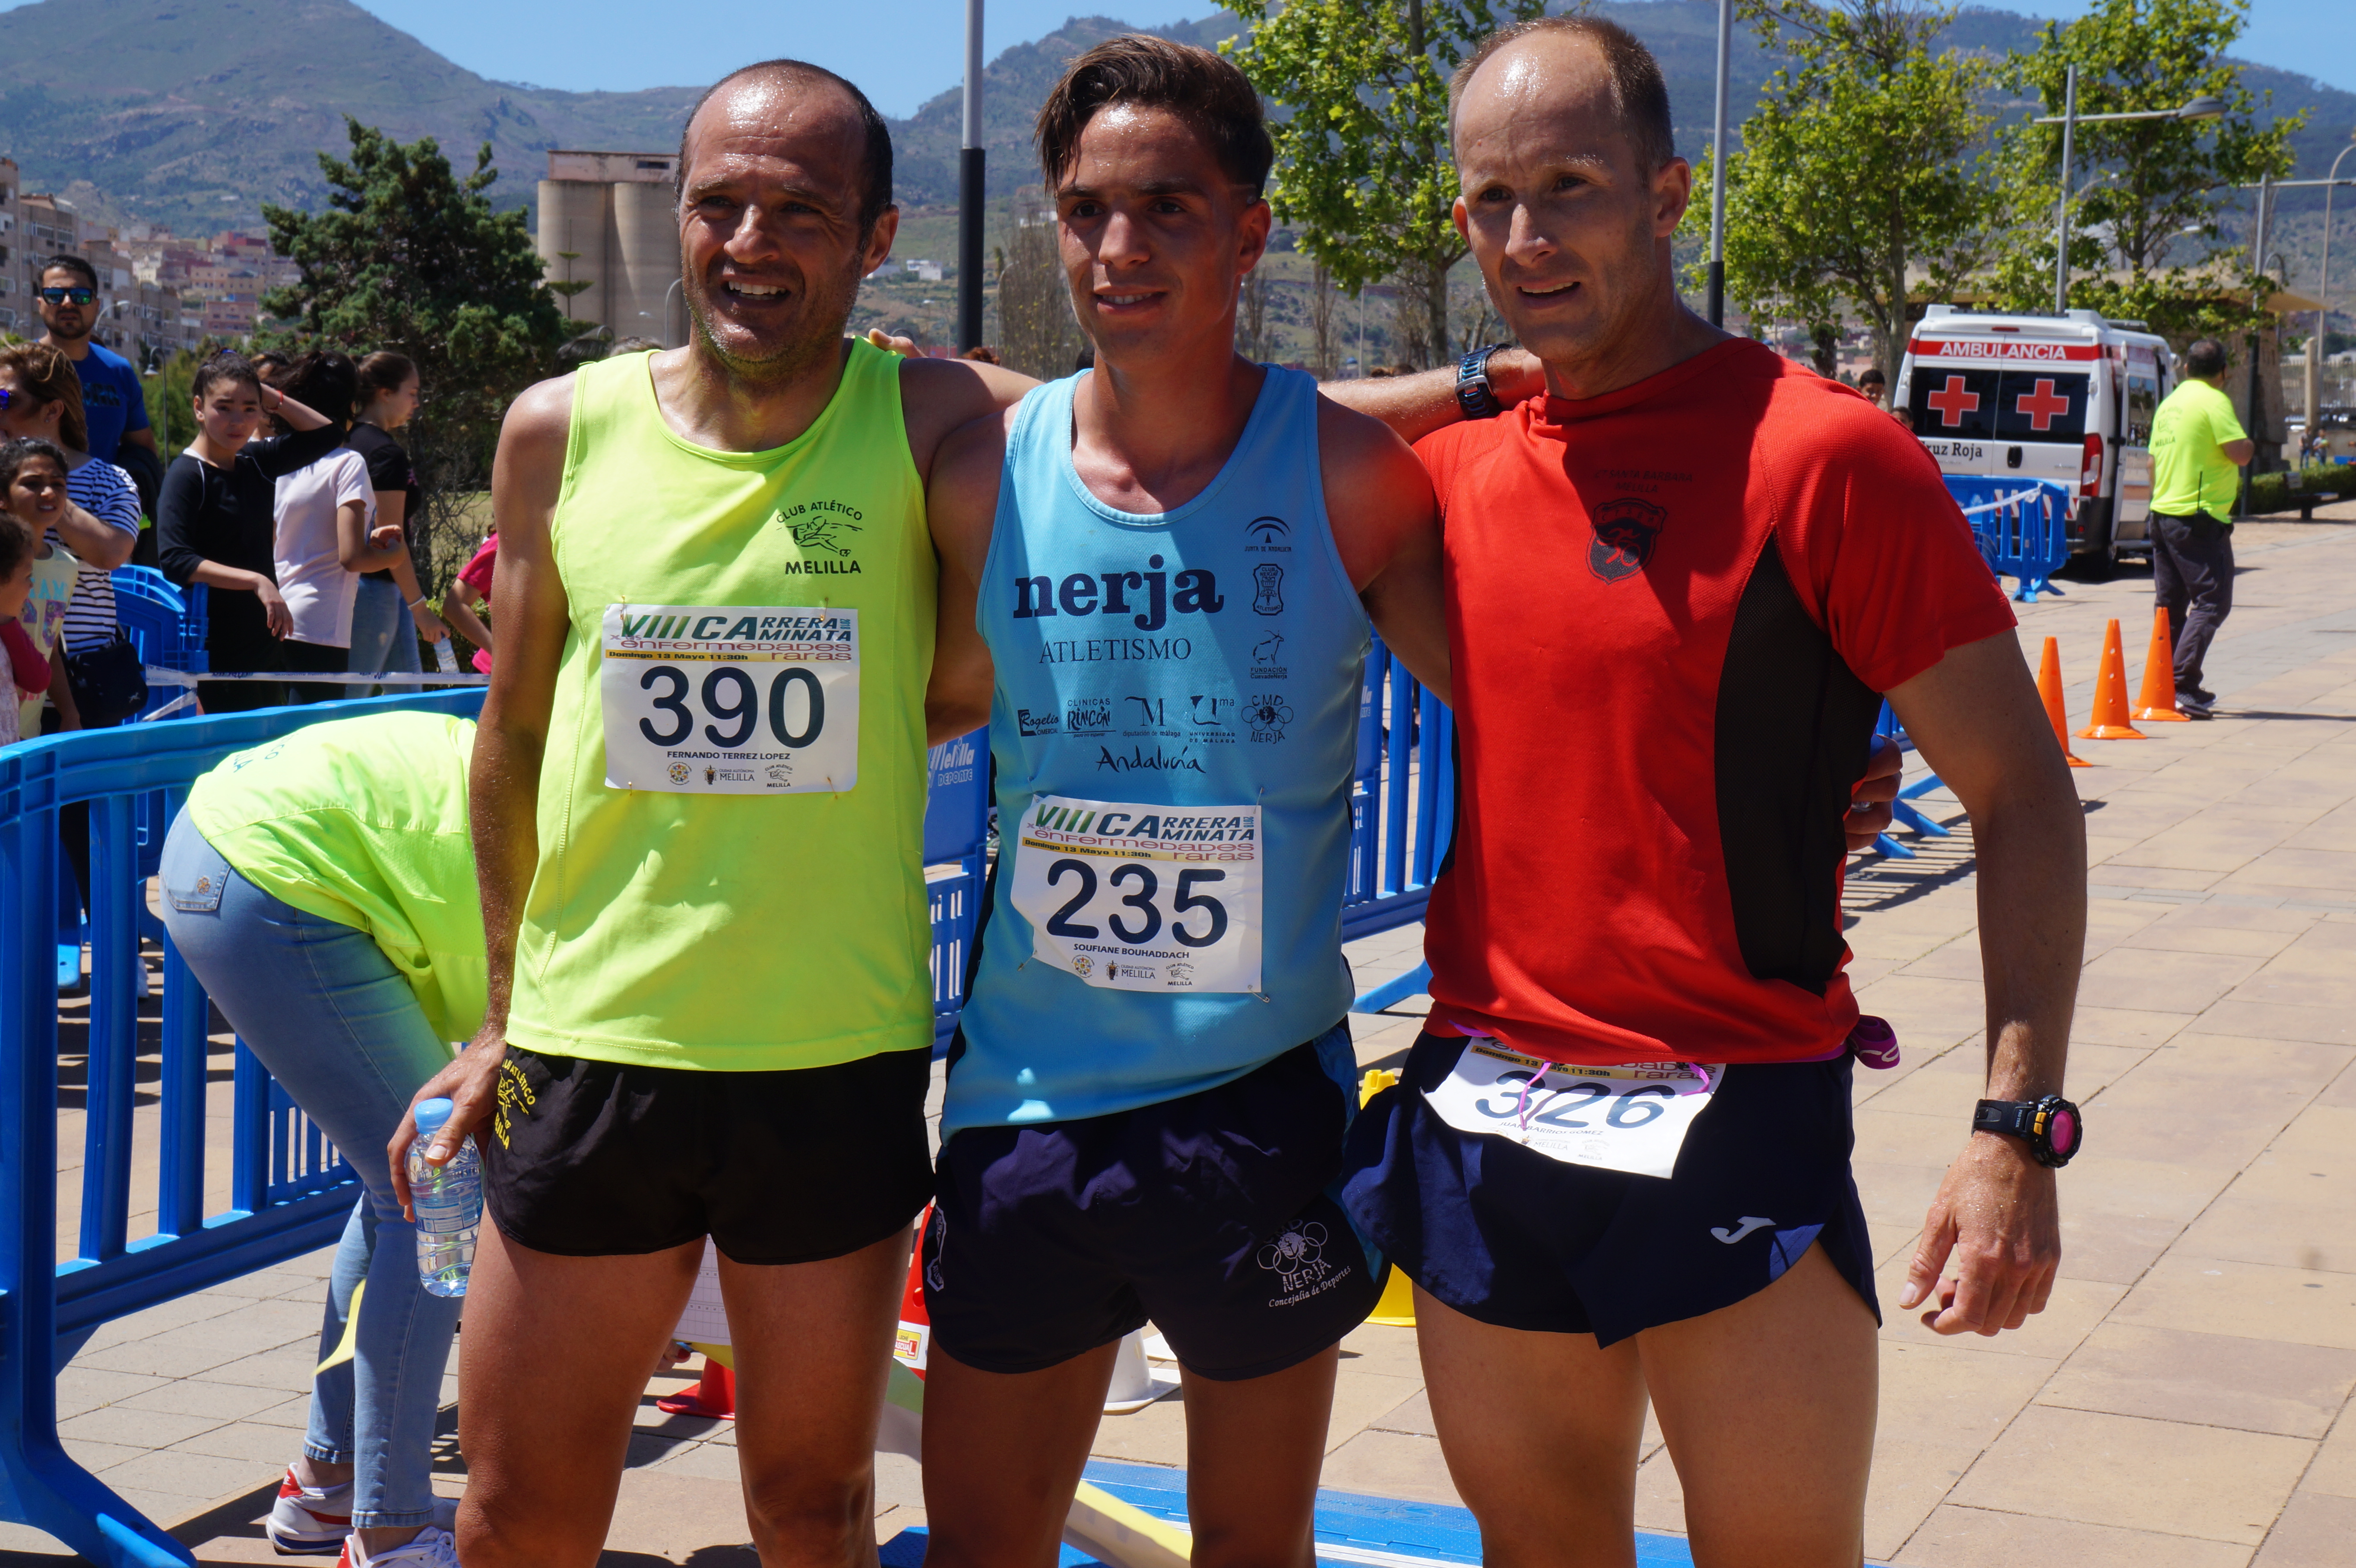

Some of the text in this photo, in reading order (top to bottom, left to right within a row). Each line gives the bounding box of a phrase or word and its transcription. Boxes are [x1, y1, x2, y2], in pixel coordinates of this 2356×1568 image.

[1939, 341, 2067, 360] AMBULANCIA
[1923, 441, 1982, 461] ruz Roja
[2155, 436, 2176, 448] MELILLA
[1643, 471, 1693, 482] BARBARA
[1614, 482, 1658, 493] MELILLA
[776, 499, 862, 523] CLUB ATLÉTICO
[785, 560, 861, 575] MELILLA
[1013, 554, 1225, 632] nerja
[609, 651, 653, 659] Domingo
[771, 651, 852, 661] raras
[1038, 638, 1192, 664] ATLETISMO
[639, 665, 824, 748] 390
[1067, 698, 1111, 707] CLINICAS
[1251, 694, 1283, 706] CMD
[1020, 711, 1059, 730] Rogelio
[667, 751, 720, 759] FERNANDO
[1095, 745, 1206, 774] Andalucía
[719, 773, 755, 781] MELILLA
[938, 768, 973, 787] DEPORTE
[1025, 839, 1061, 851] Domingo
[1113, 850, 1151, 858] 11:30h
[1173, 852, 1255, 861] raras
[1046, 858, 1228, 948] 235
[1074, 943, 1190, 958] SOUFIANE BOUHADDACH
[1121, 968, 1156, 979] MELILLA
[1475, 1047, 1521, 1063] Domingo
[1541, 1062, 1568, 1072] ayo
[1571, 1068, 1610, 1077] 11:30h
[510, 1065, 536, 1106] ATLÉTICO
[1475, 1070, 1676, 1129] 326
[1526, 1125, 1567, 1135] BARRIOS
[1533, 1141, 1568, 1151] MELILLA
[1282, 1258, 1332, 1293] NERJA
[1311, 1285, 1320, 1295] de
[1320, 1265, 1352, 1292] Deportes
